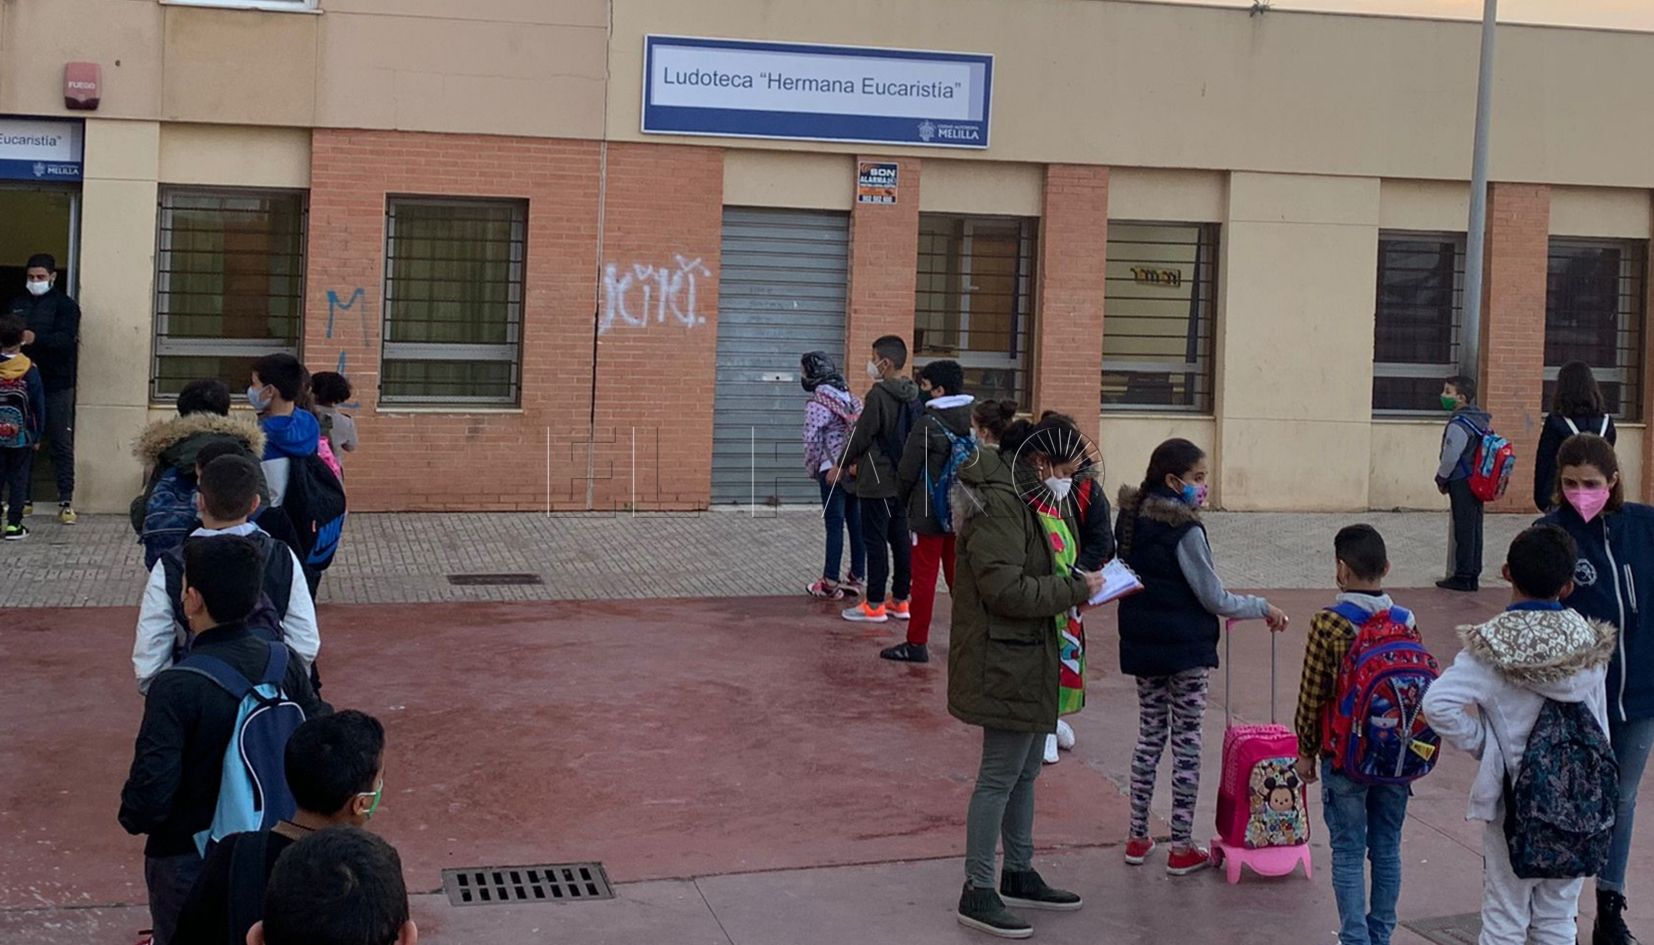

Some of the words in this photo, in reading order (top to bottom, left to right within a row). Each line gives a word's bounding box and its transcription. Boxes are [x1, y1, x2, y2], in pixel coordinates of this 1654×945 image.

[663, 66, 753, 88] Ludoteca
[938, 128, 980, 140] MELILLA
[47, 167, 80, 175] MELILLA
[870, 168, 896, 177] SON
